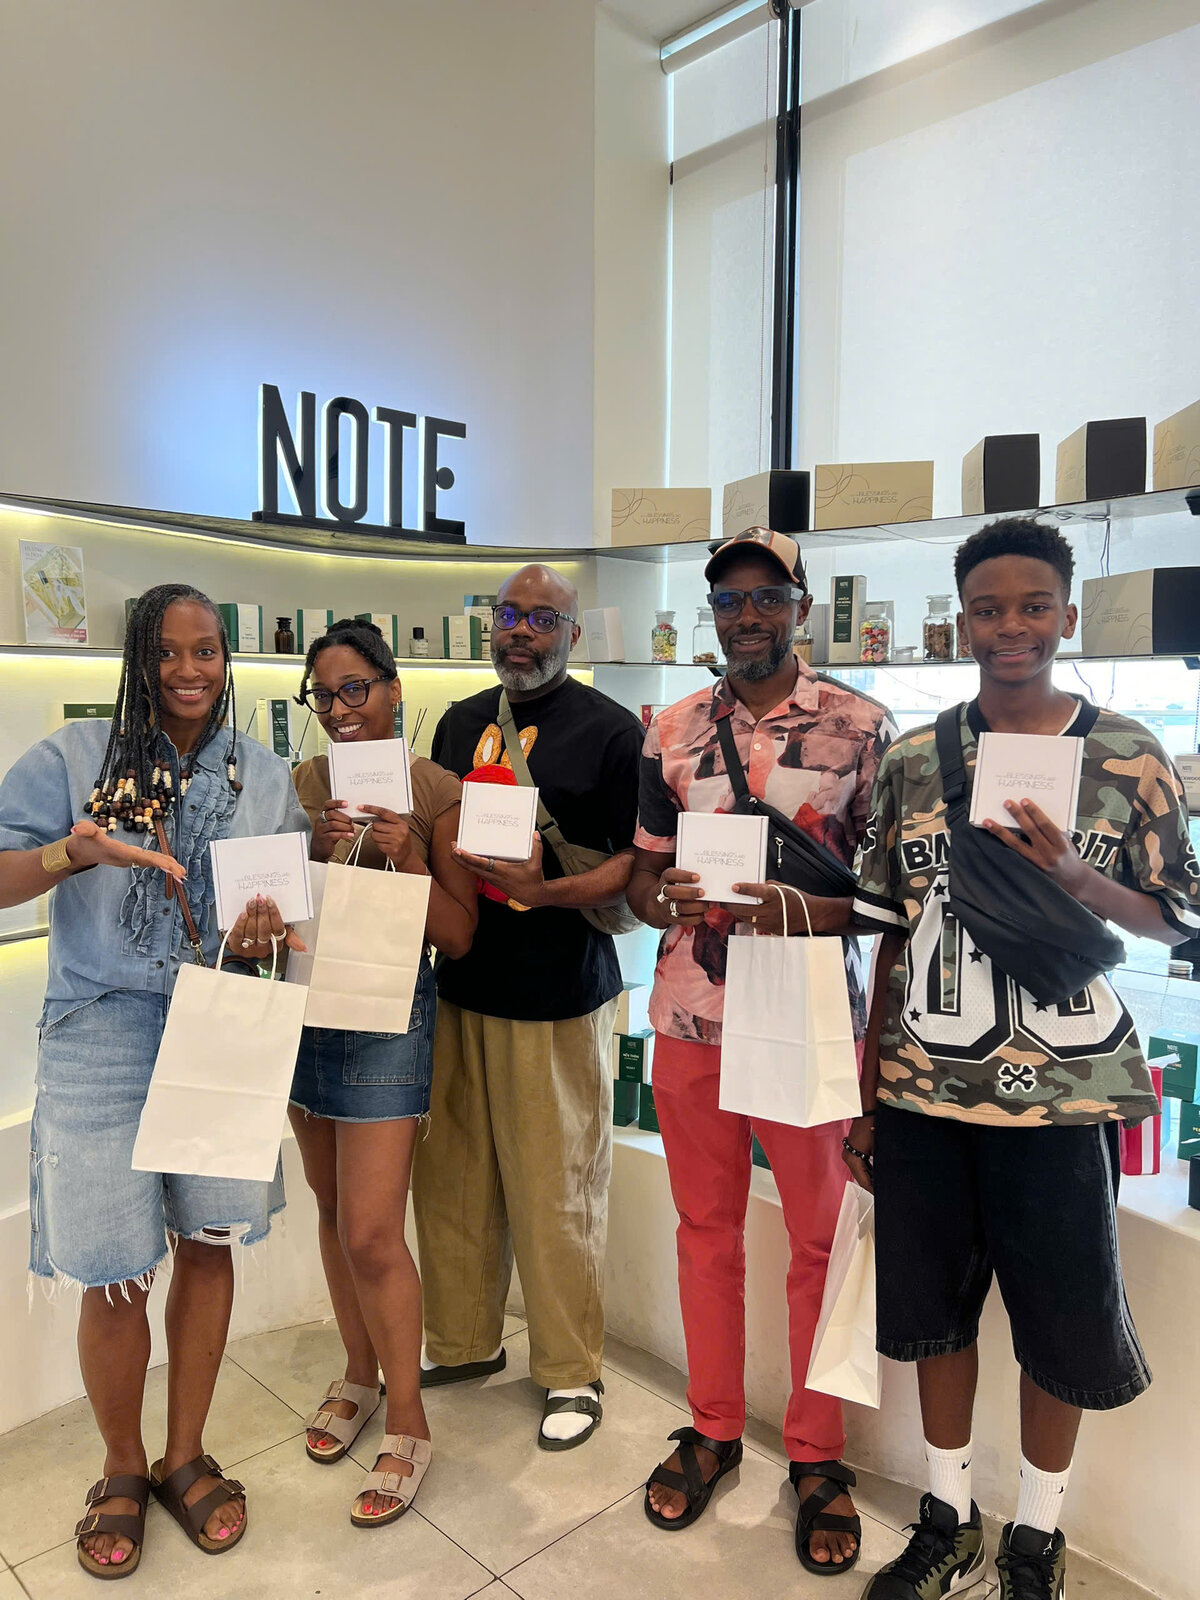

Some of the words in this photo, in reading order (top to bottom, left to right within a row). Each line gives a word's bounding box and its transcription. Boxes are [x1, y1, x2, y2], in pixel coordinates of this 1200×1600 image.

[258, 383, 466, 537] NOTE
[852, 496, 897, 504] HAPPINESS
[642, 517, 680, 525] HAPPINESS
[349, 776, 393, 786] HAPPINESS
[998, 778, 1055, 791] HAPPINESS
[477, 817, 520, 828] HAPPINESS
[696, 856, 745, 867] HAPPINESS
[238, 877, 289, 890] HAPPINESS
